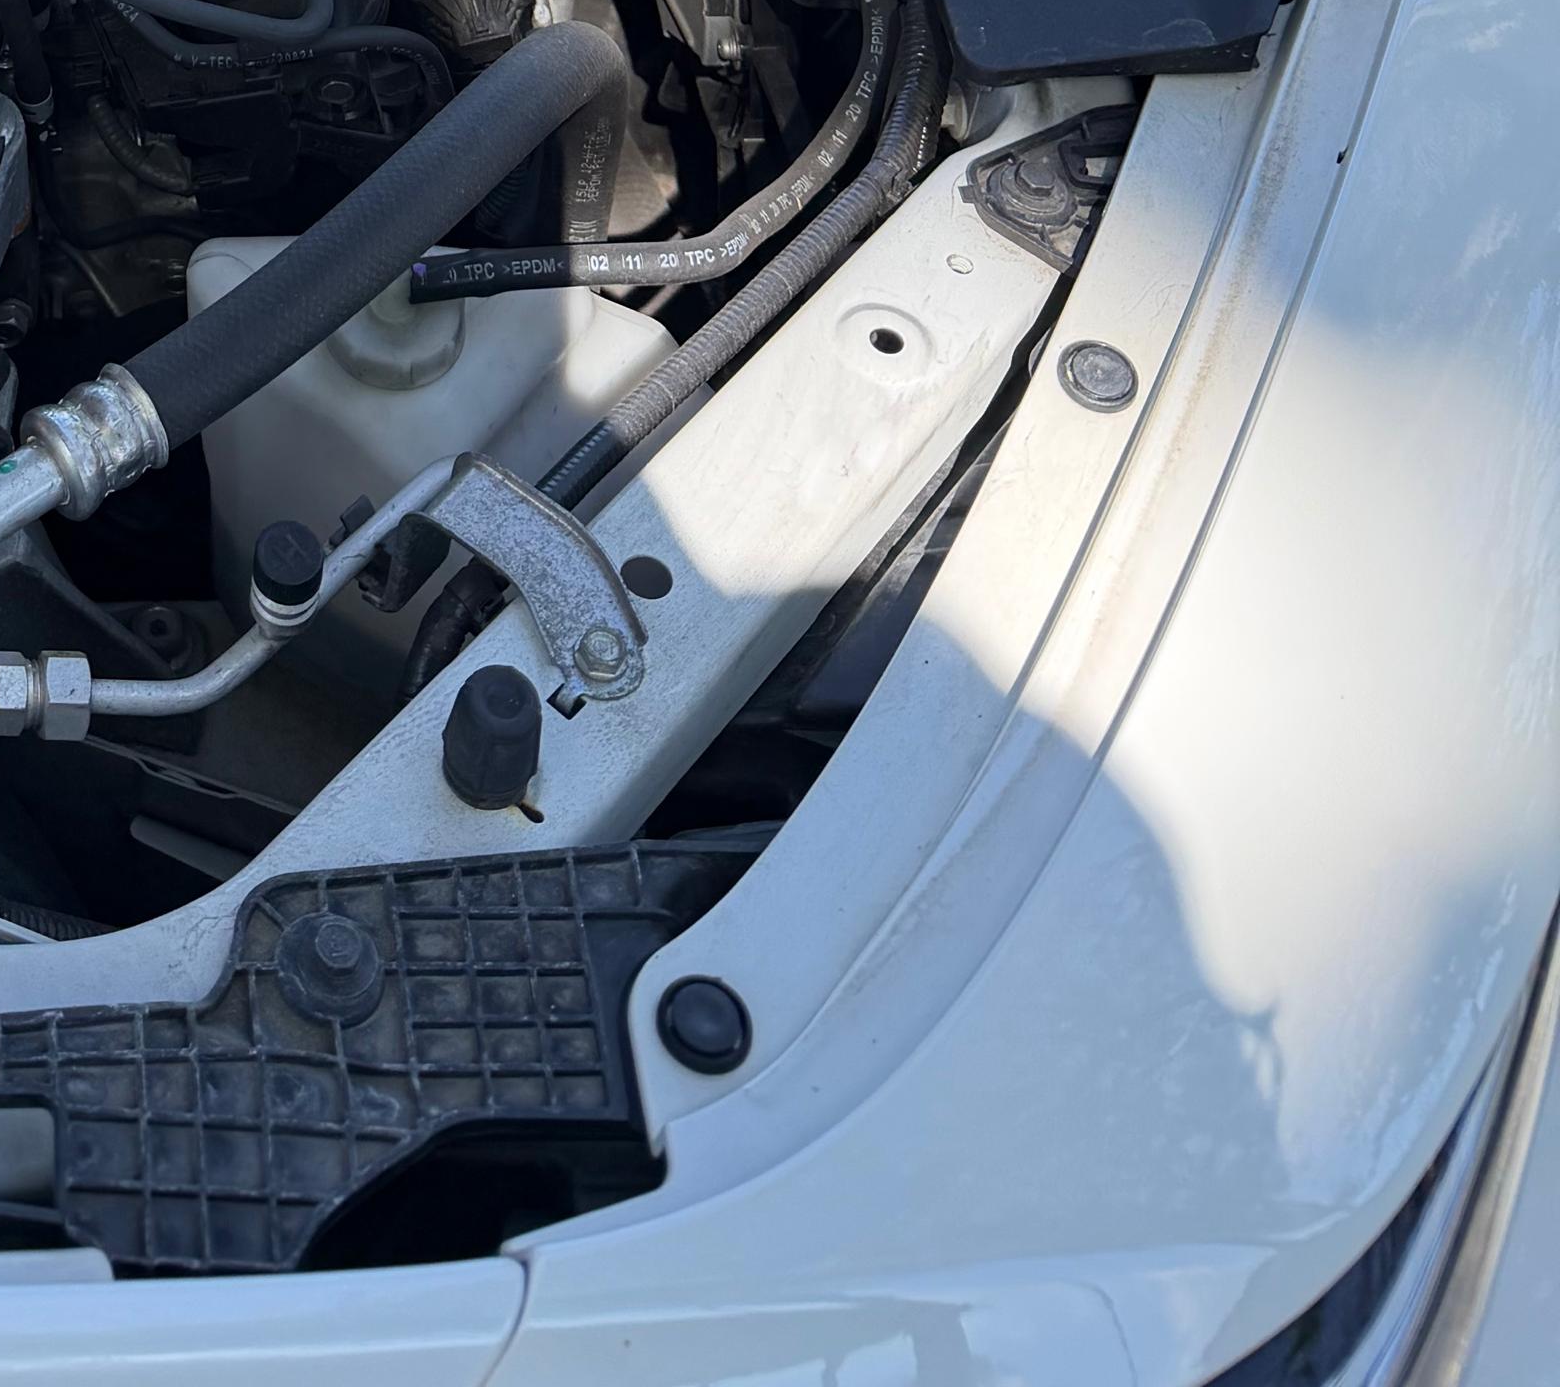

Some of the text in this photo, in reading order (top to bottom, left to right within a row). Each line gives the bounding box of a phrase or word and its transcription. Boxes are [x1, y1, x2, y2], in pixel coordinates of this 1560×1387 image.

[845, 103, 862, 123] 20
[855, 70, 877, 99] TPC
[464, 263, 495, 282] TPC
[589, 255, 609, 274] 02
[624, 254, 643, 272] 11
[659, 252, 679, 269] 20
[684, 249, 716, 268] TPC
